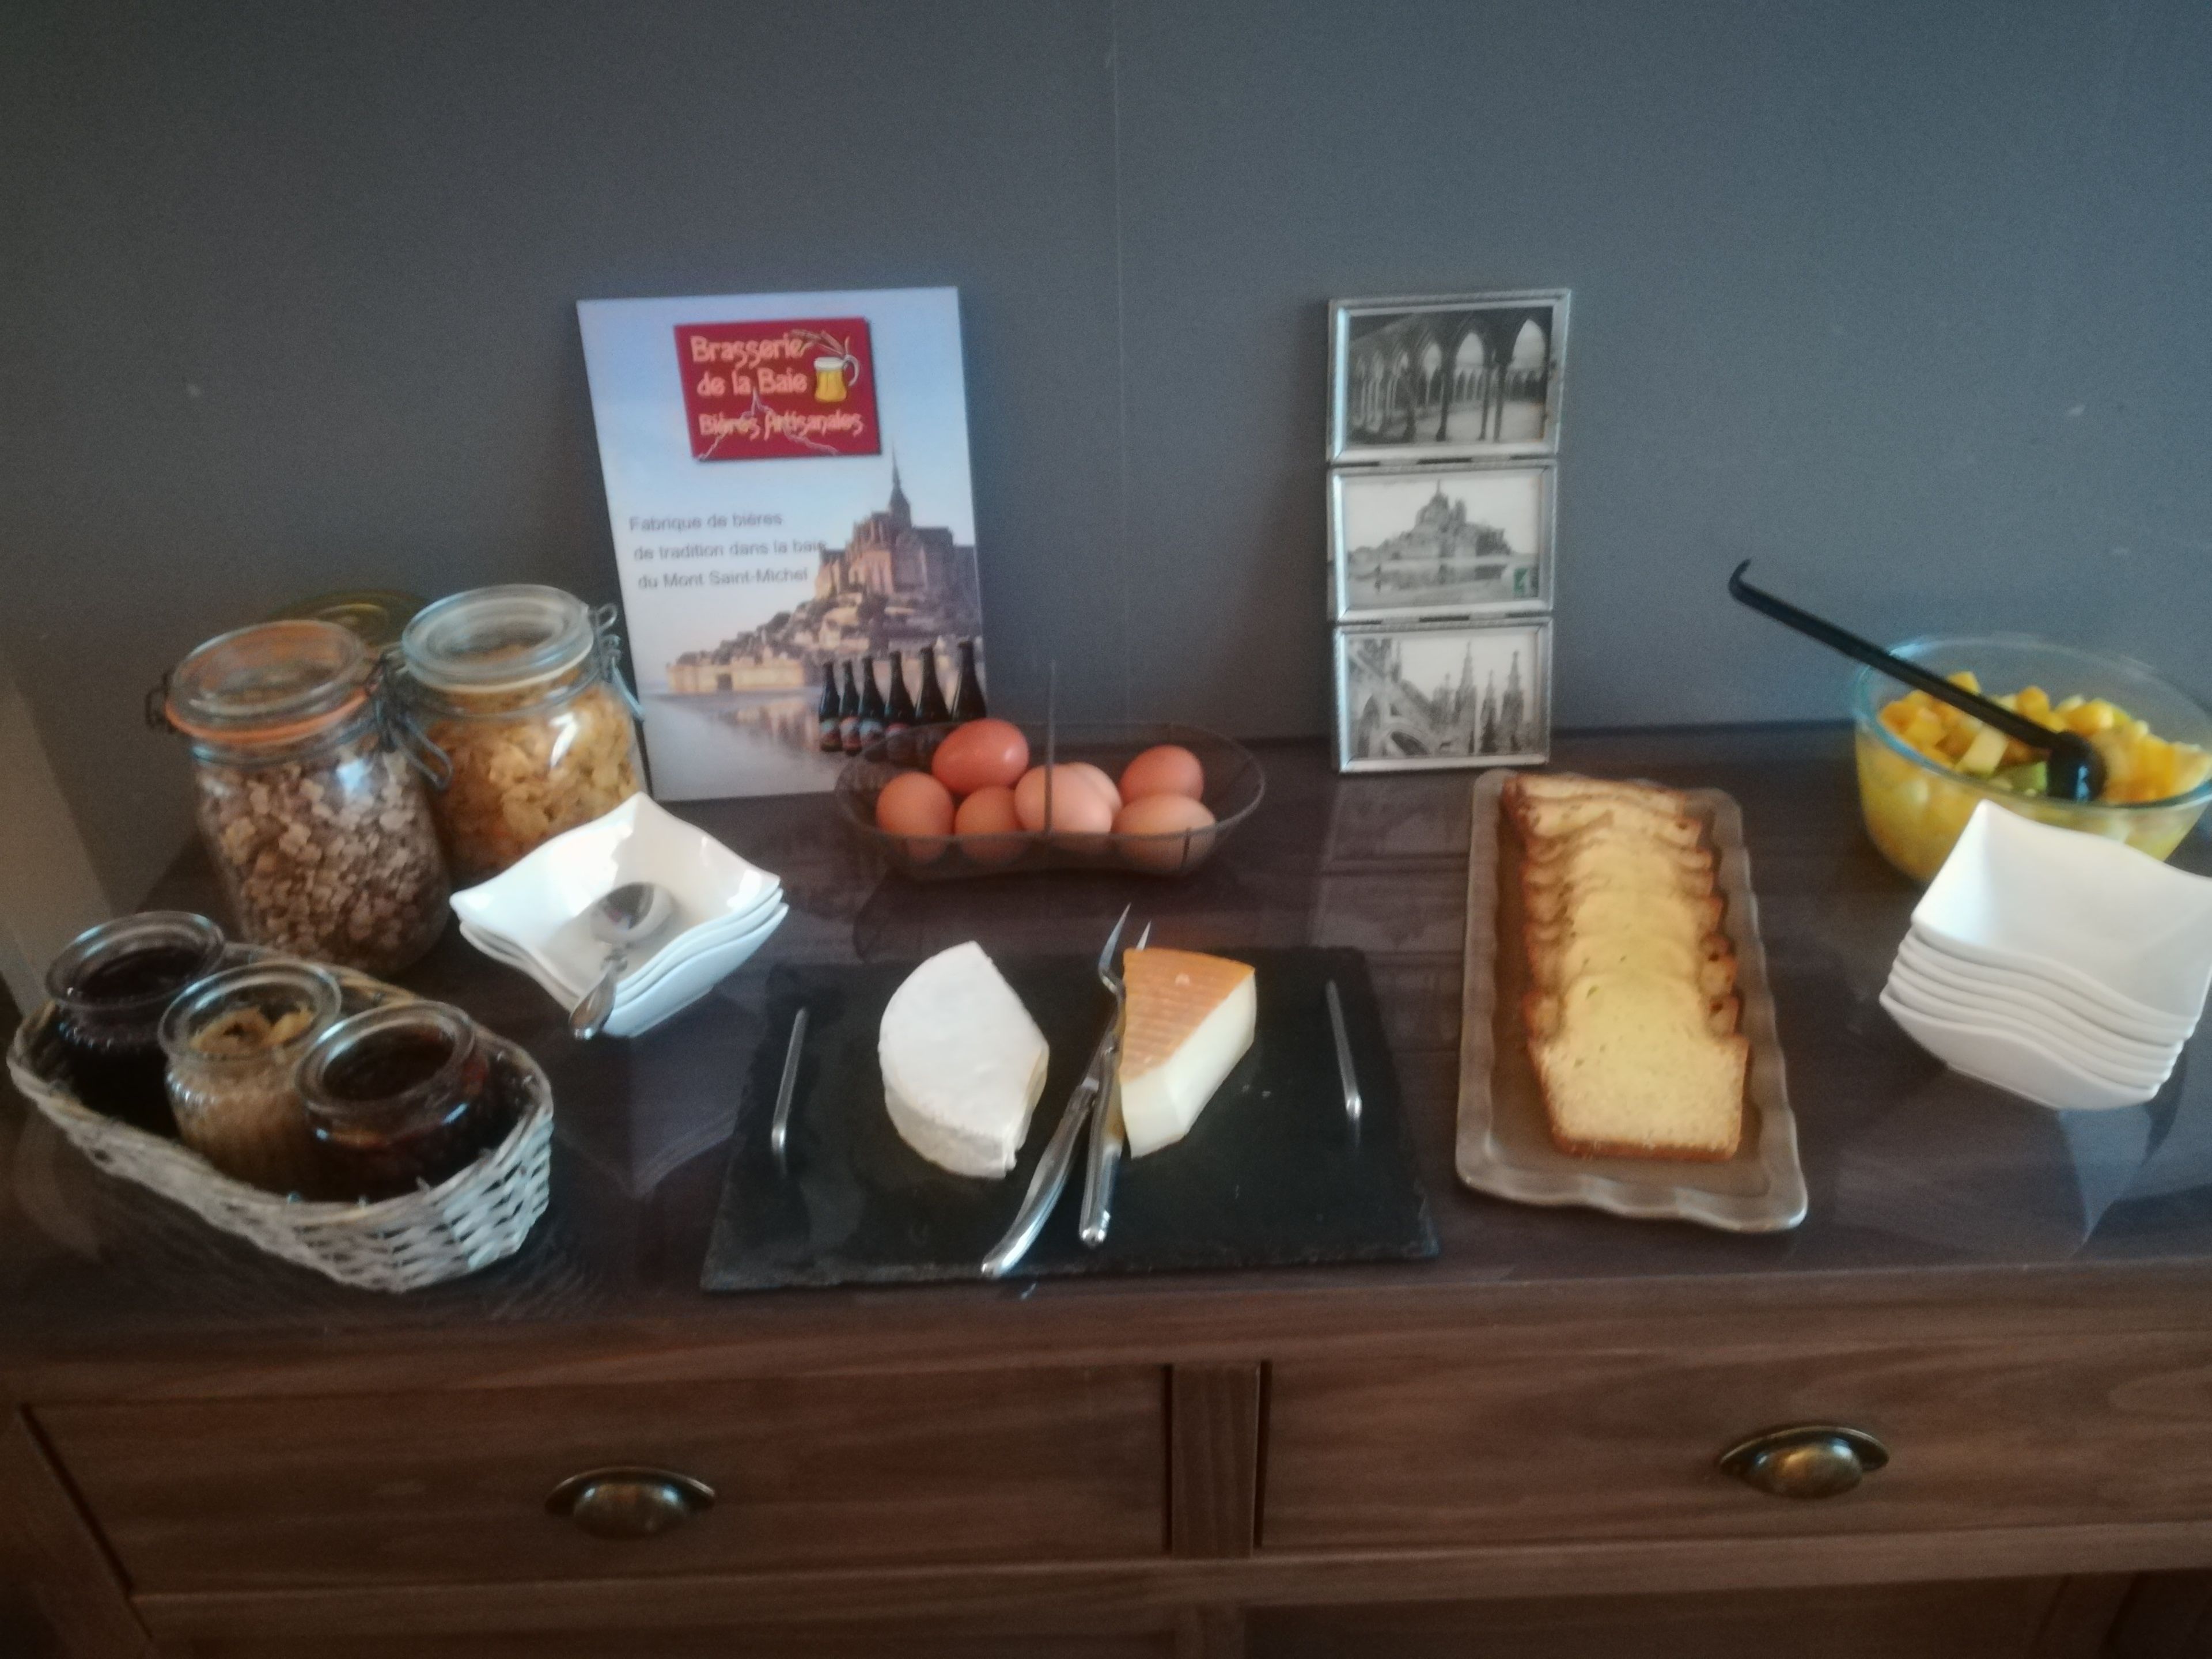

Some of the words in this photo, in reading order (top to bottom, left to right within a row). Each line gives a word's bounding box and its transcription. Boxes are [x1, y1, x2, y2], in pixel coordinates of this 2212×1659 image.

[690, 334, 802, 368] Brasserie
[697, 370, 725, 396] de
[732, 369, 751, 395] la
[757, 367, 808, 394] Baie
[629, 516, 701, 533] Fabrique
[707, 514, 726, 528] de
[634, 546, 653, 560] de
[660, 543, 724, 559] tradition
[729, 542, 768, 556] dans
[774, 540, 787, 554] la
[639, 574, 657, 589] du
[664, 573, 703, 588] Mont
[709, 567, 808, 584] Saint-Michel
